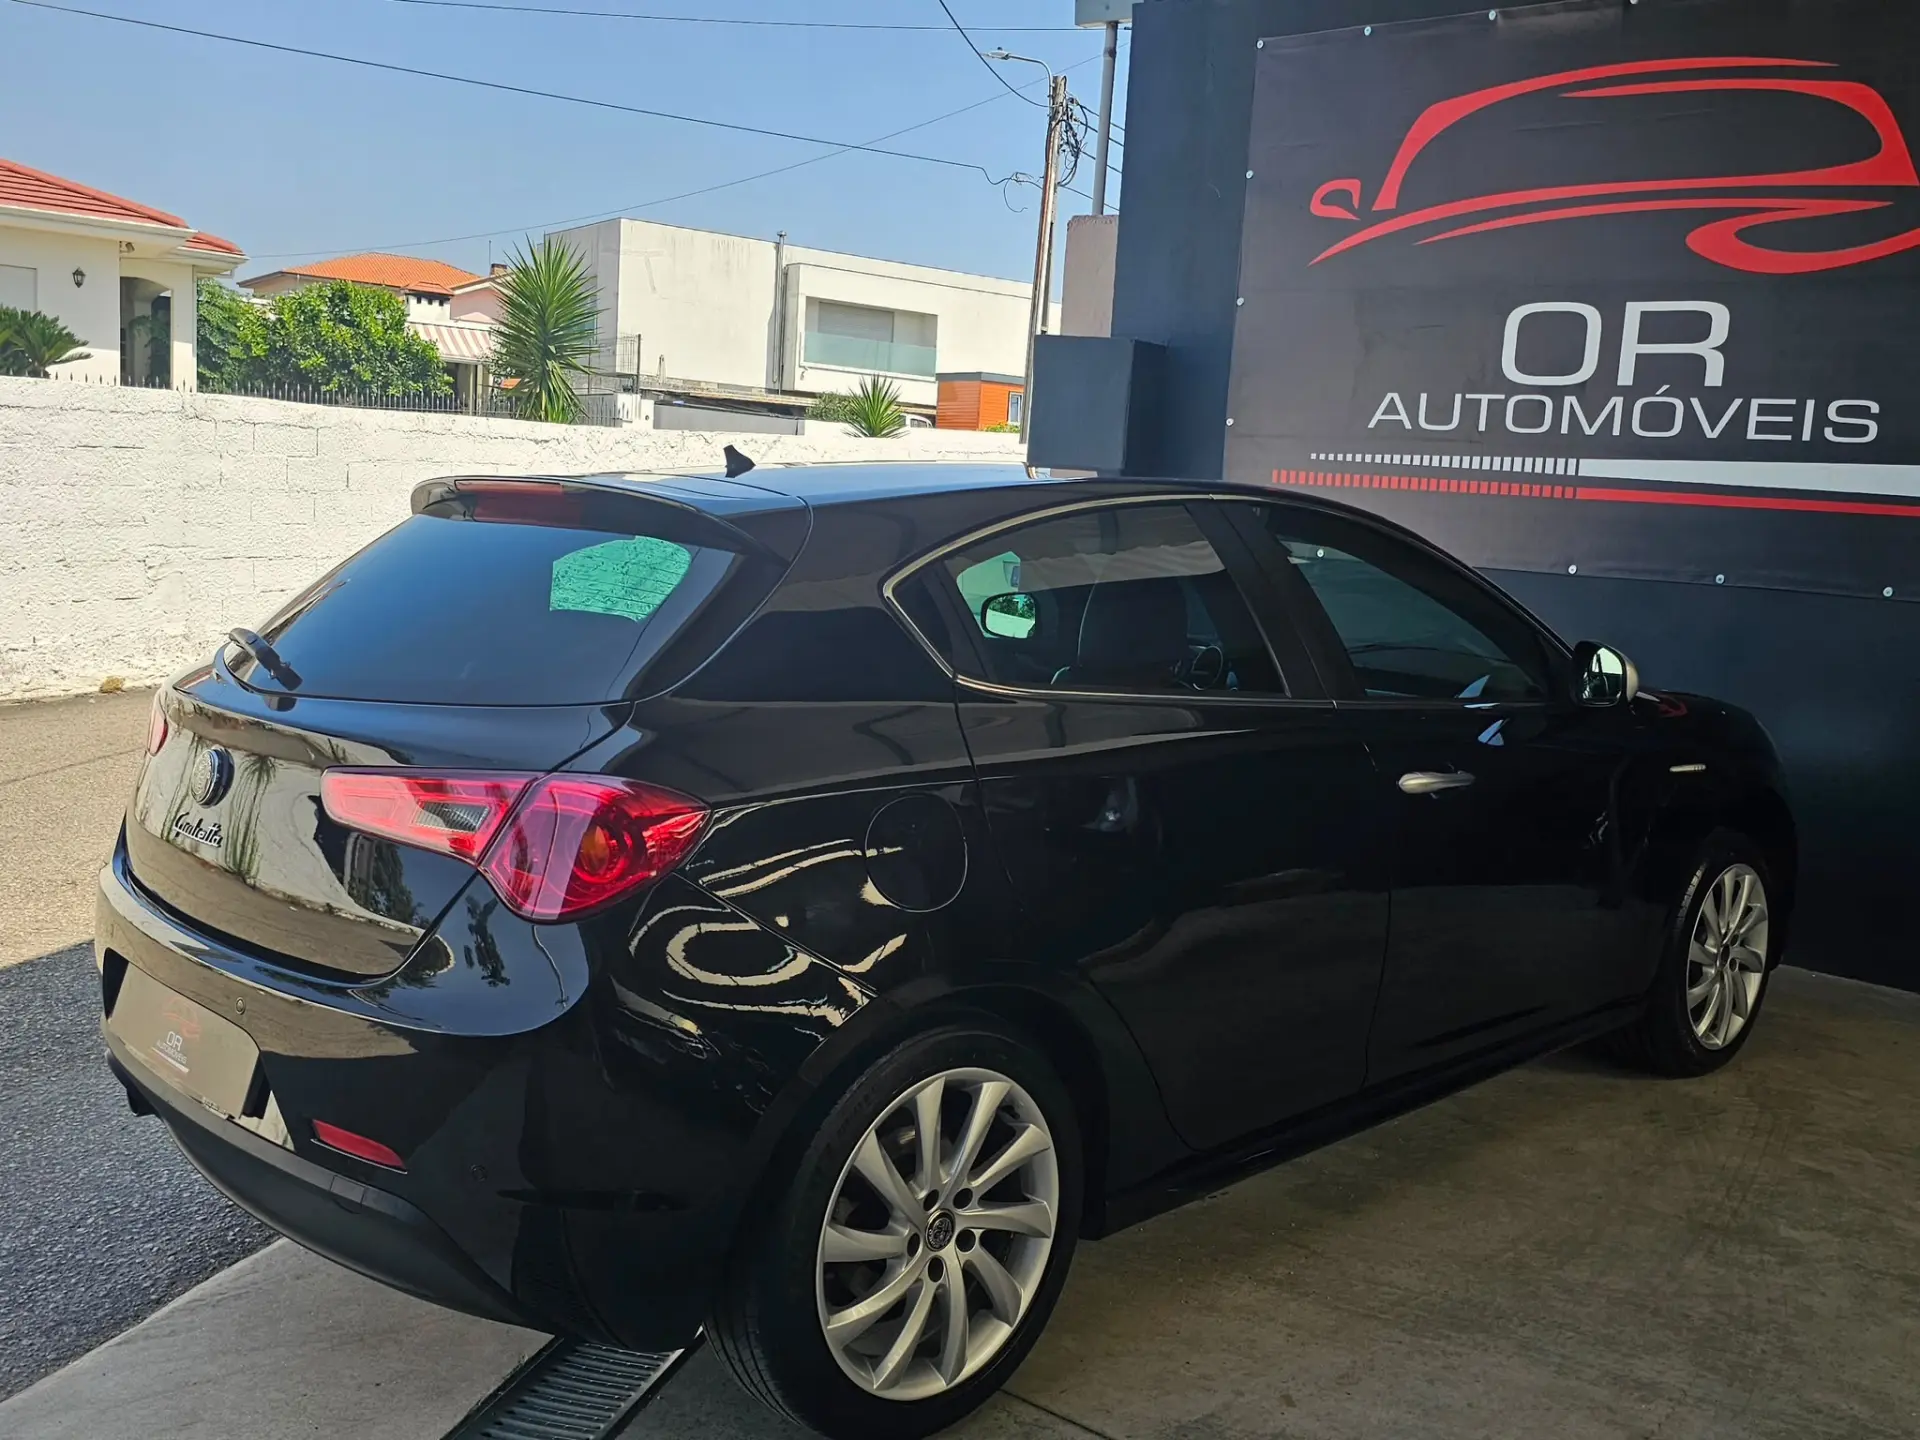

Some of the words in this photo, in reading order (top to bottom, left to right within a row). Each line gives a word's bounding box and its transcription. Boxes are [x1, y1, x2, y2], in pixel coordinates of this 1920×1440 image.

[1500, 300, 1731, 388] OR
[1367, 385, 1881, 445] AUTOMÓVEIS
[166, 1031, 183, 1051] OR
